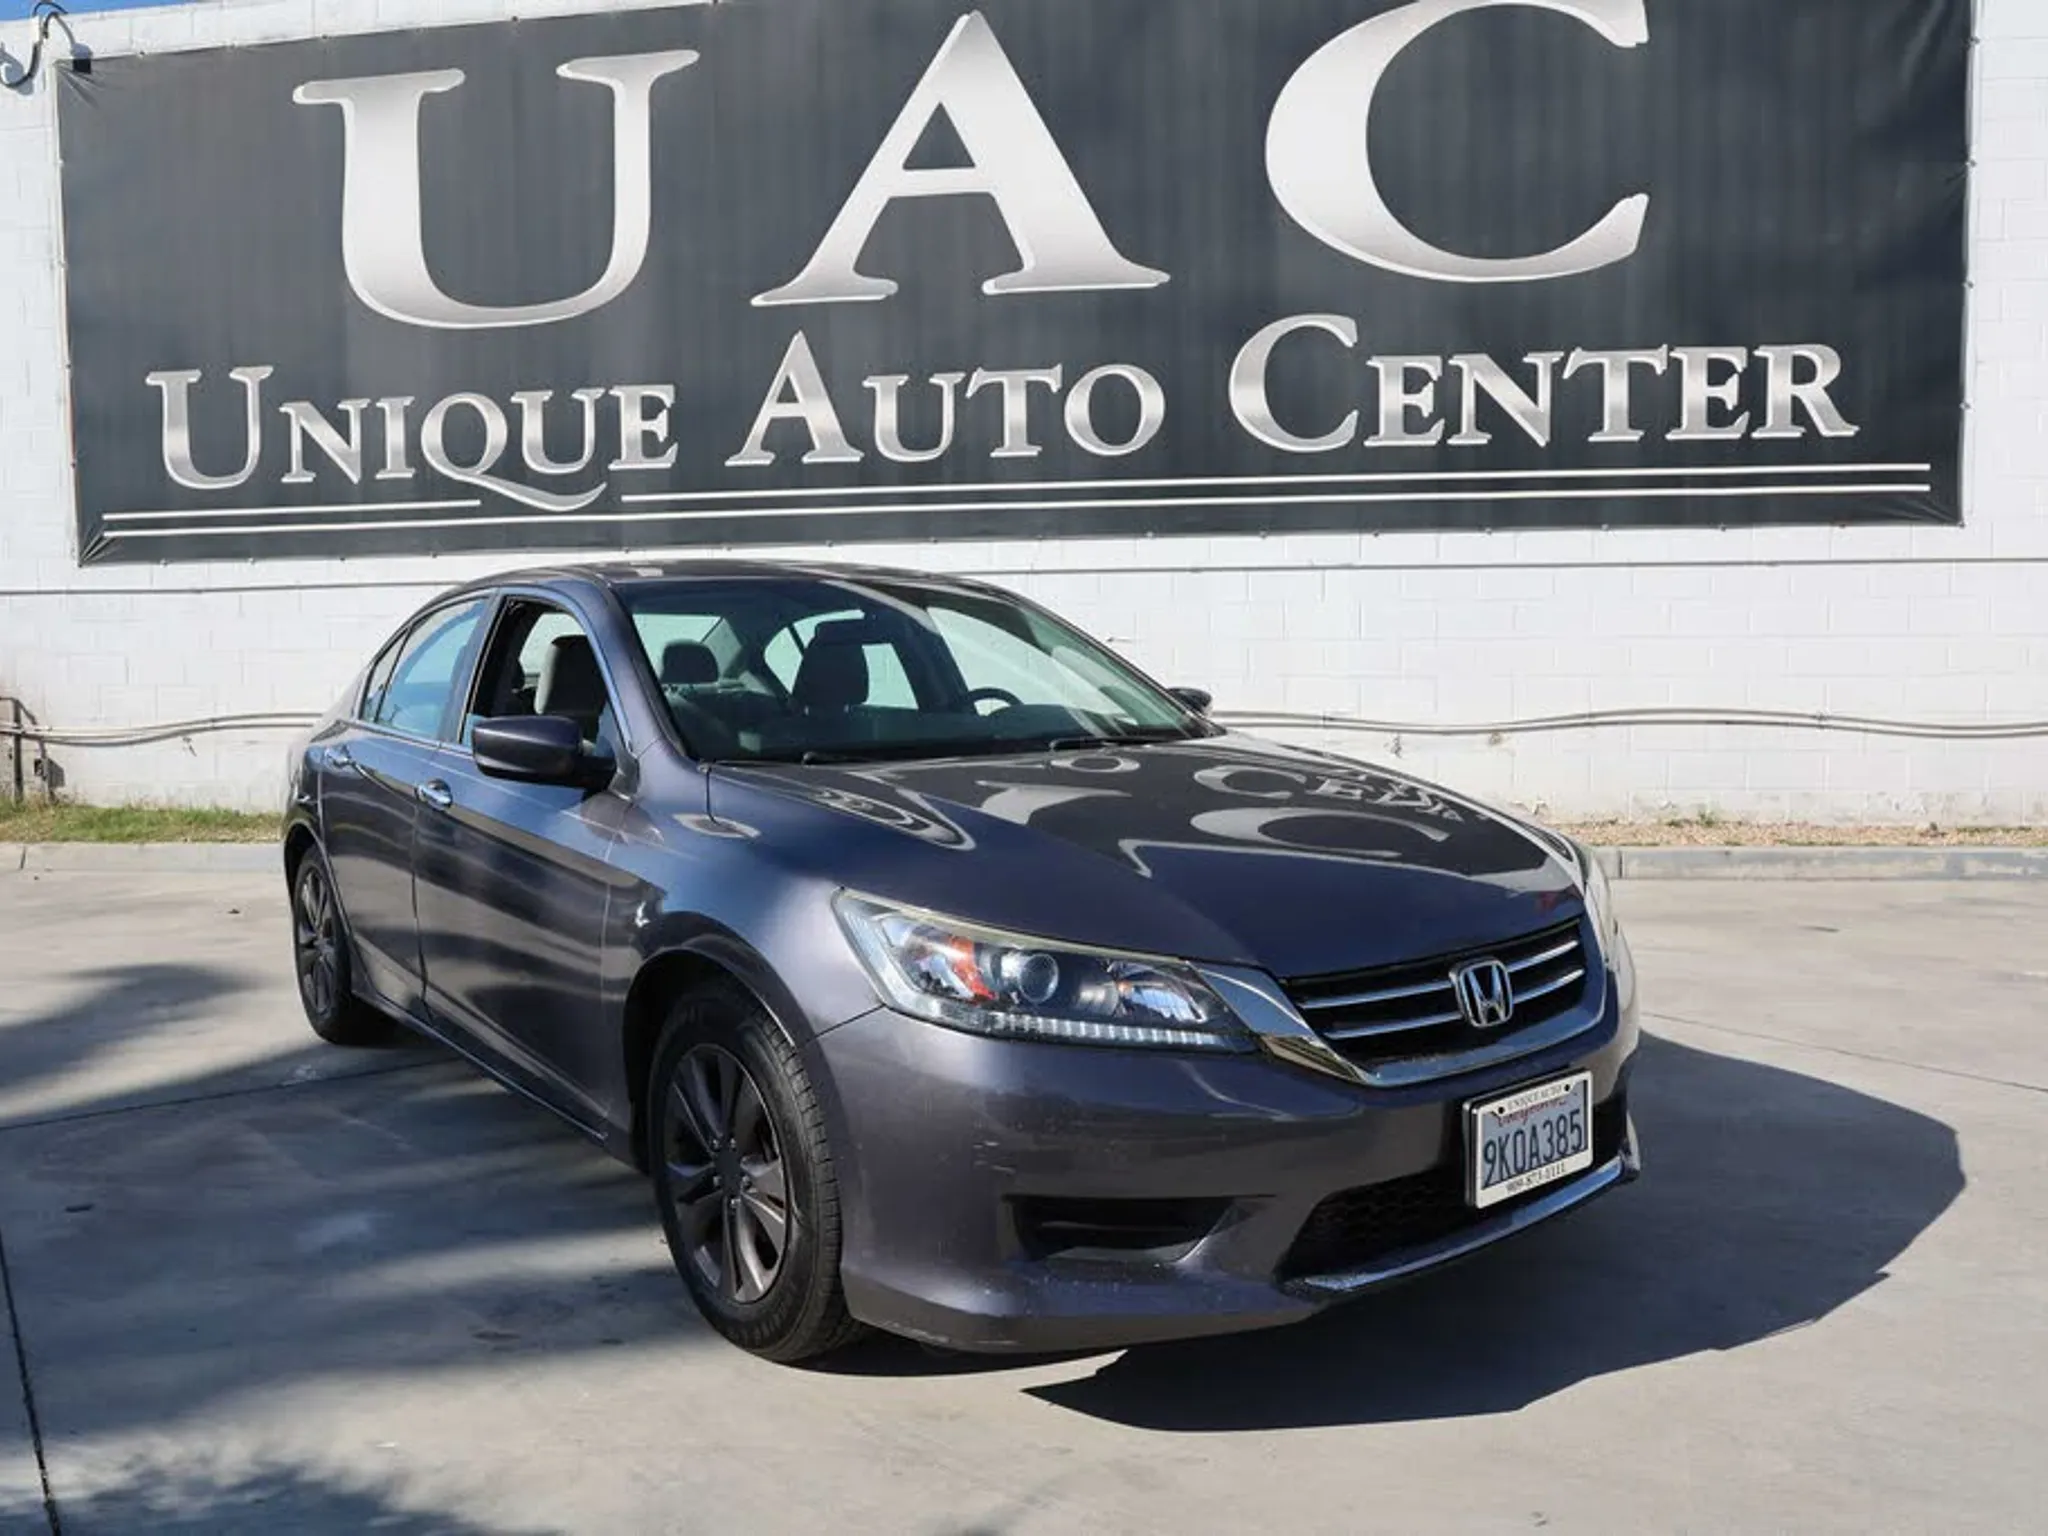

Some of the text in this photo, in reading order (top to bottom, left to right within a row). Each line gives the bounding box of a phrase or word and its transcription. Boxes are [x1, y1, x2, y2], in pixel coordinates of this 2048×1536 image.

[291, 0, 1650, 331] UAC
[144, 313, 1860, 512] UNIQUE AUTO CENTER
